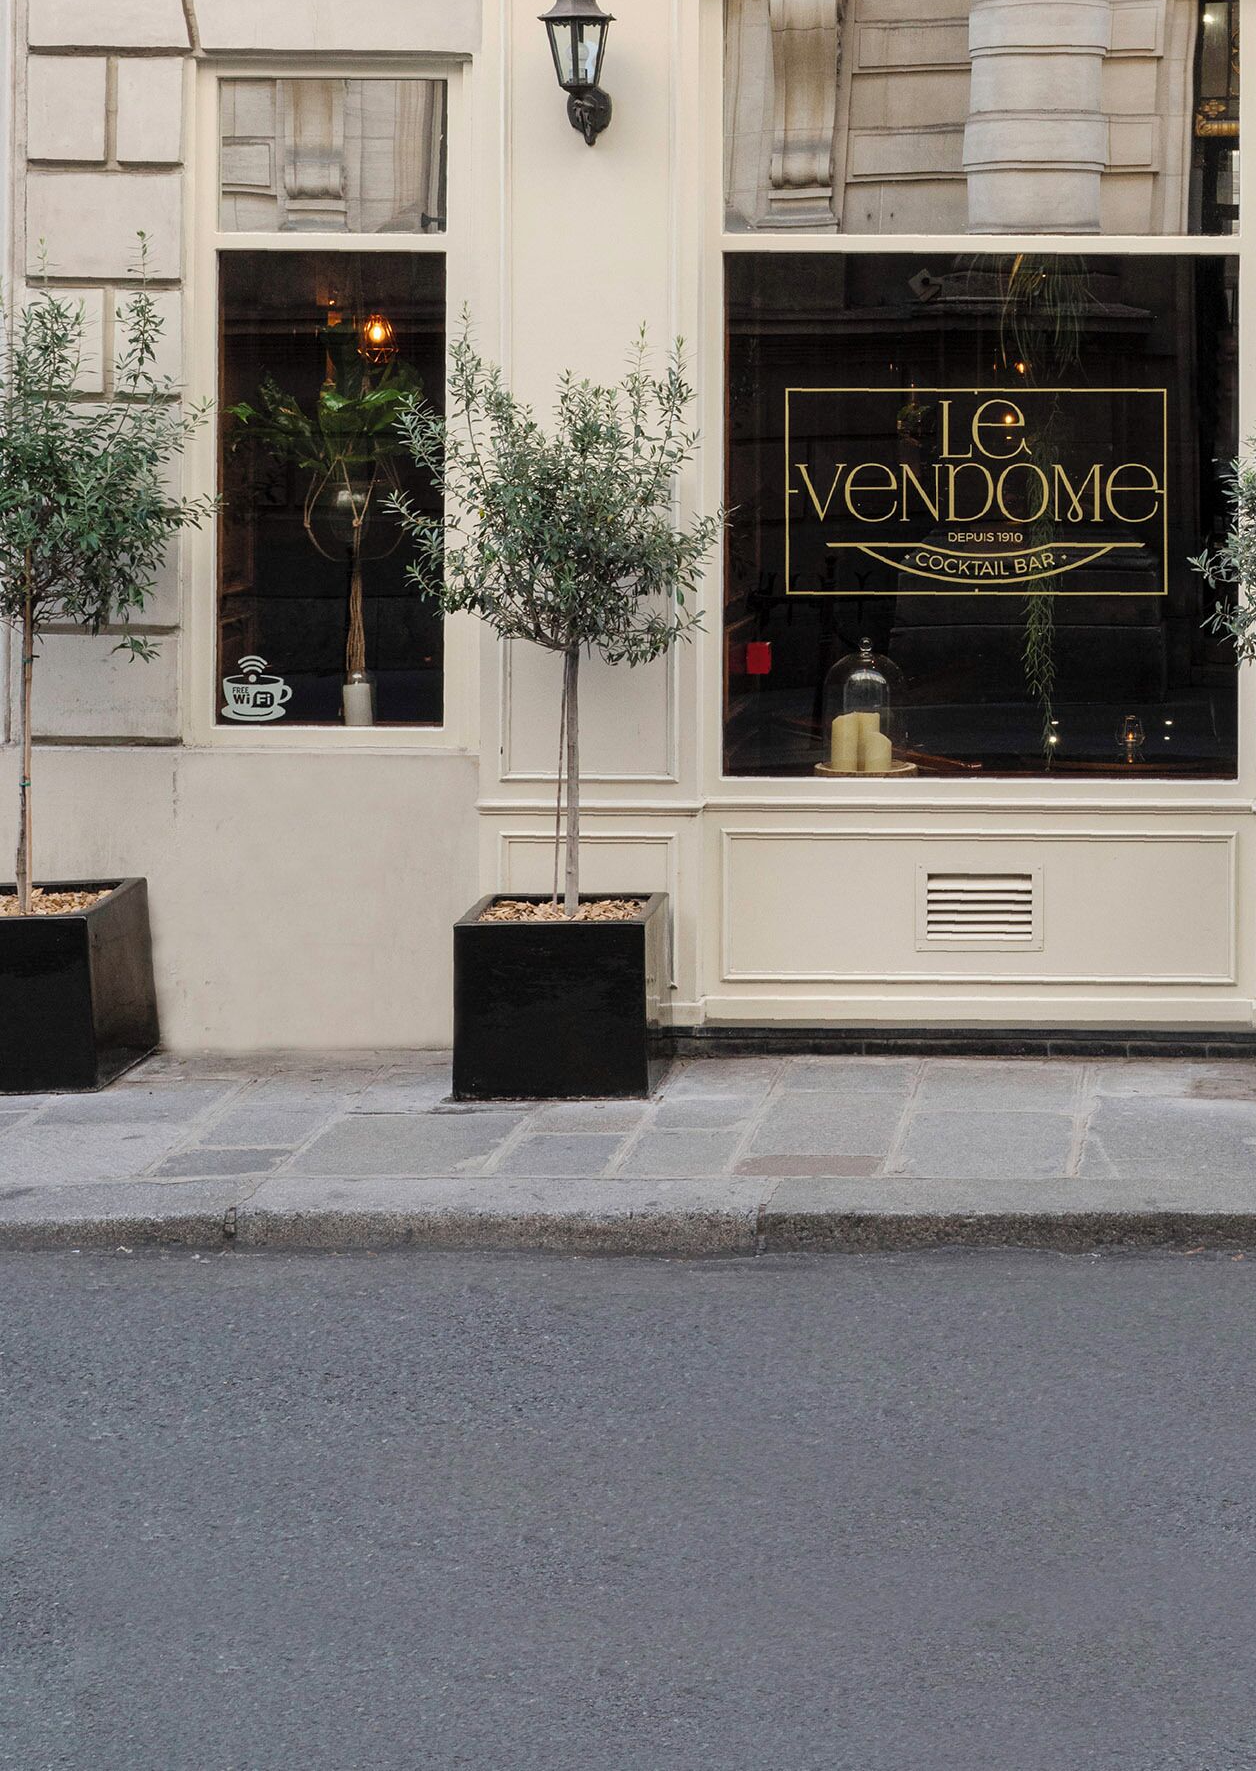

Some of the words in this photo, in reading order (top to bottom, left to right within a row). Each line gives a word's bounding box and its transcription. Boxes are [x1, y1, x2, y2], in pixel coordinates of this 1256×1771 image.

[947, 532, 995, 543] DEPUIS
[996, 532, 1023, 543] 1910
[915, 551, 1009, 576] COCKTAIL
[1014, 552, 1056, 575] BAR
[232, 686, 249, 694] FREE
